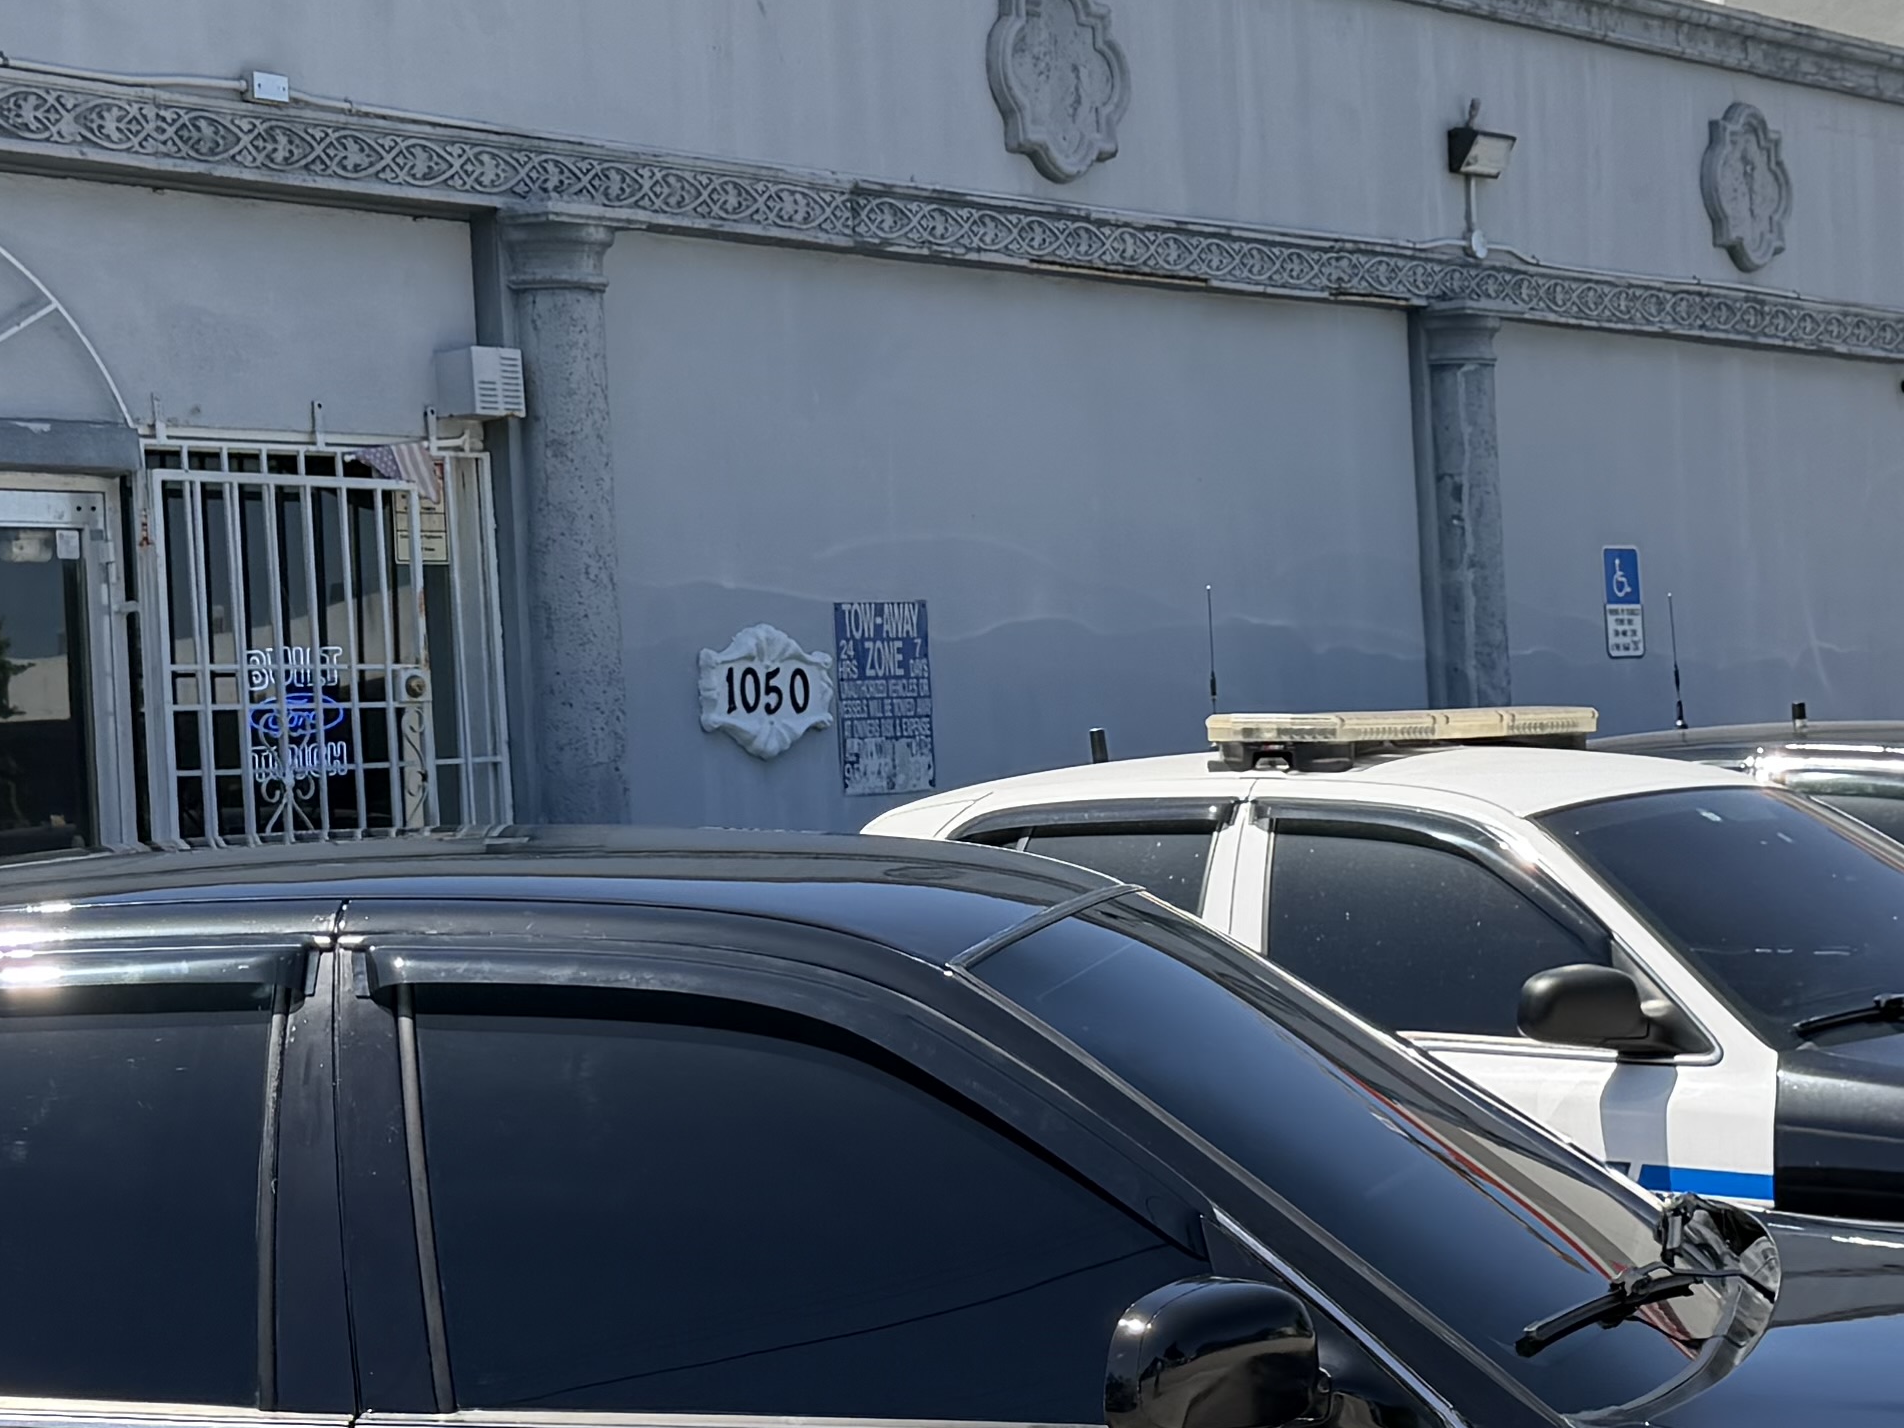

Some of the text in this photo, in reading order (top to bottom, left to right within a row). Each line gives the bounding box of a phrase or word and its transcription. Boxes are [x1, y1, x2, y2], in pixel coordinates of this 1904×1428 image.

[841, 603, 918, 639] TOW-AWAY
[245, 646, 343, 691] BUILT
[839, 638, 922, 677] 24 ZONE 7
[726, 666, 809, 715] 1050
[251, 741, 347, 782] TOUGH
